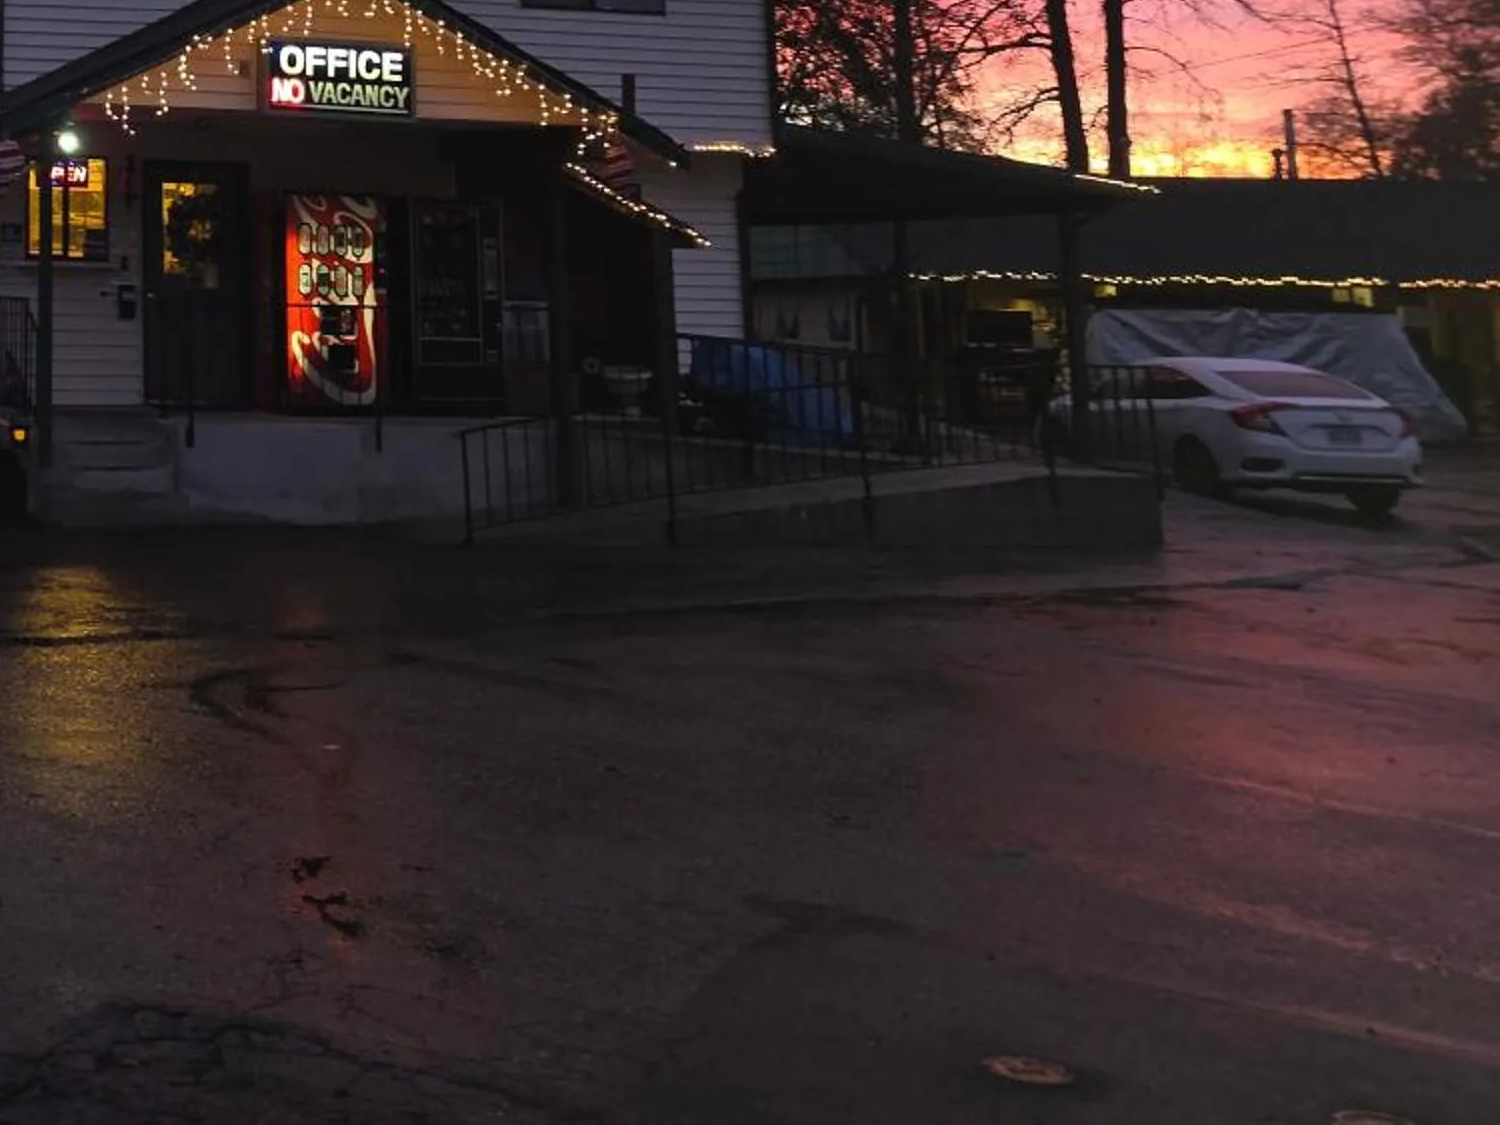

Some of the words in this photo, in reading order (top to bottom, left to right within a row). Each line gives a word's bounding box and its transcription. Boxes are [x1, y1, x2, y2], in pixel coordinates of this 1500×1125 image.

[279, 45, 403, 82] OFFICE
[272, 78, 305, 103] NO
[309, 81, 409, 108] VACANCY
[50, 166, 87, 182] PEN
